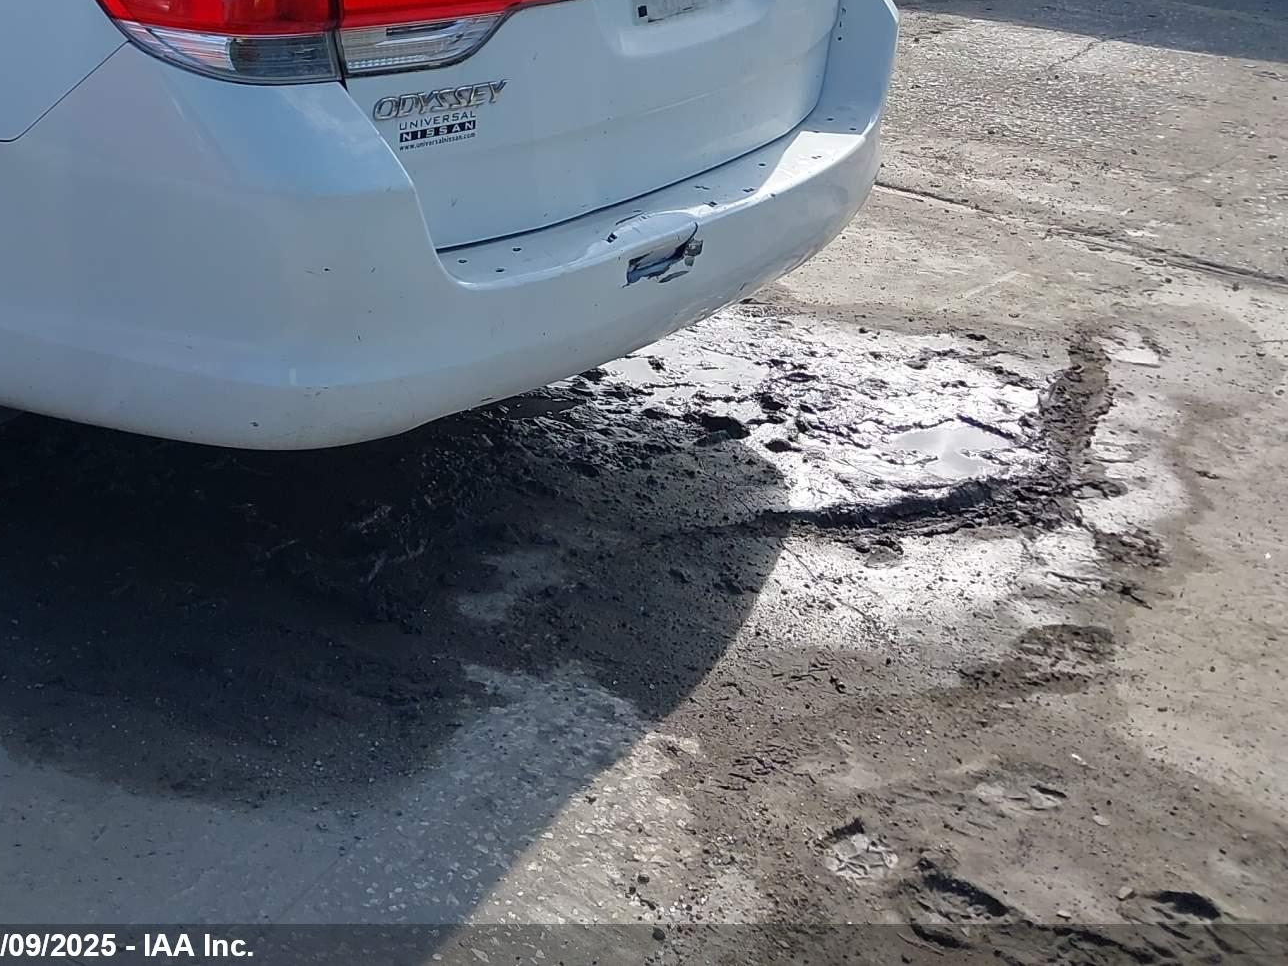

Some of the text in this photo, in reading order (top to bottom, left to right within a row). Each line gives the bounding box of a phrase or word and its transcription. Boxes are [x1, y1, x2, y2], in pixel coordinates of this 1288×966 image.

[373, 78, 510, 121] ODYSSEY
[399, 110, 476, 131] UNIVERSAL
[400, 121, 475, 142] NISSAN
